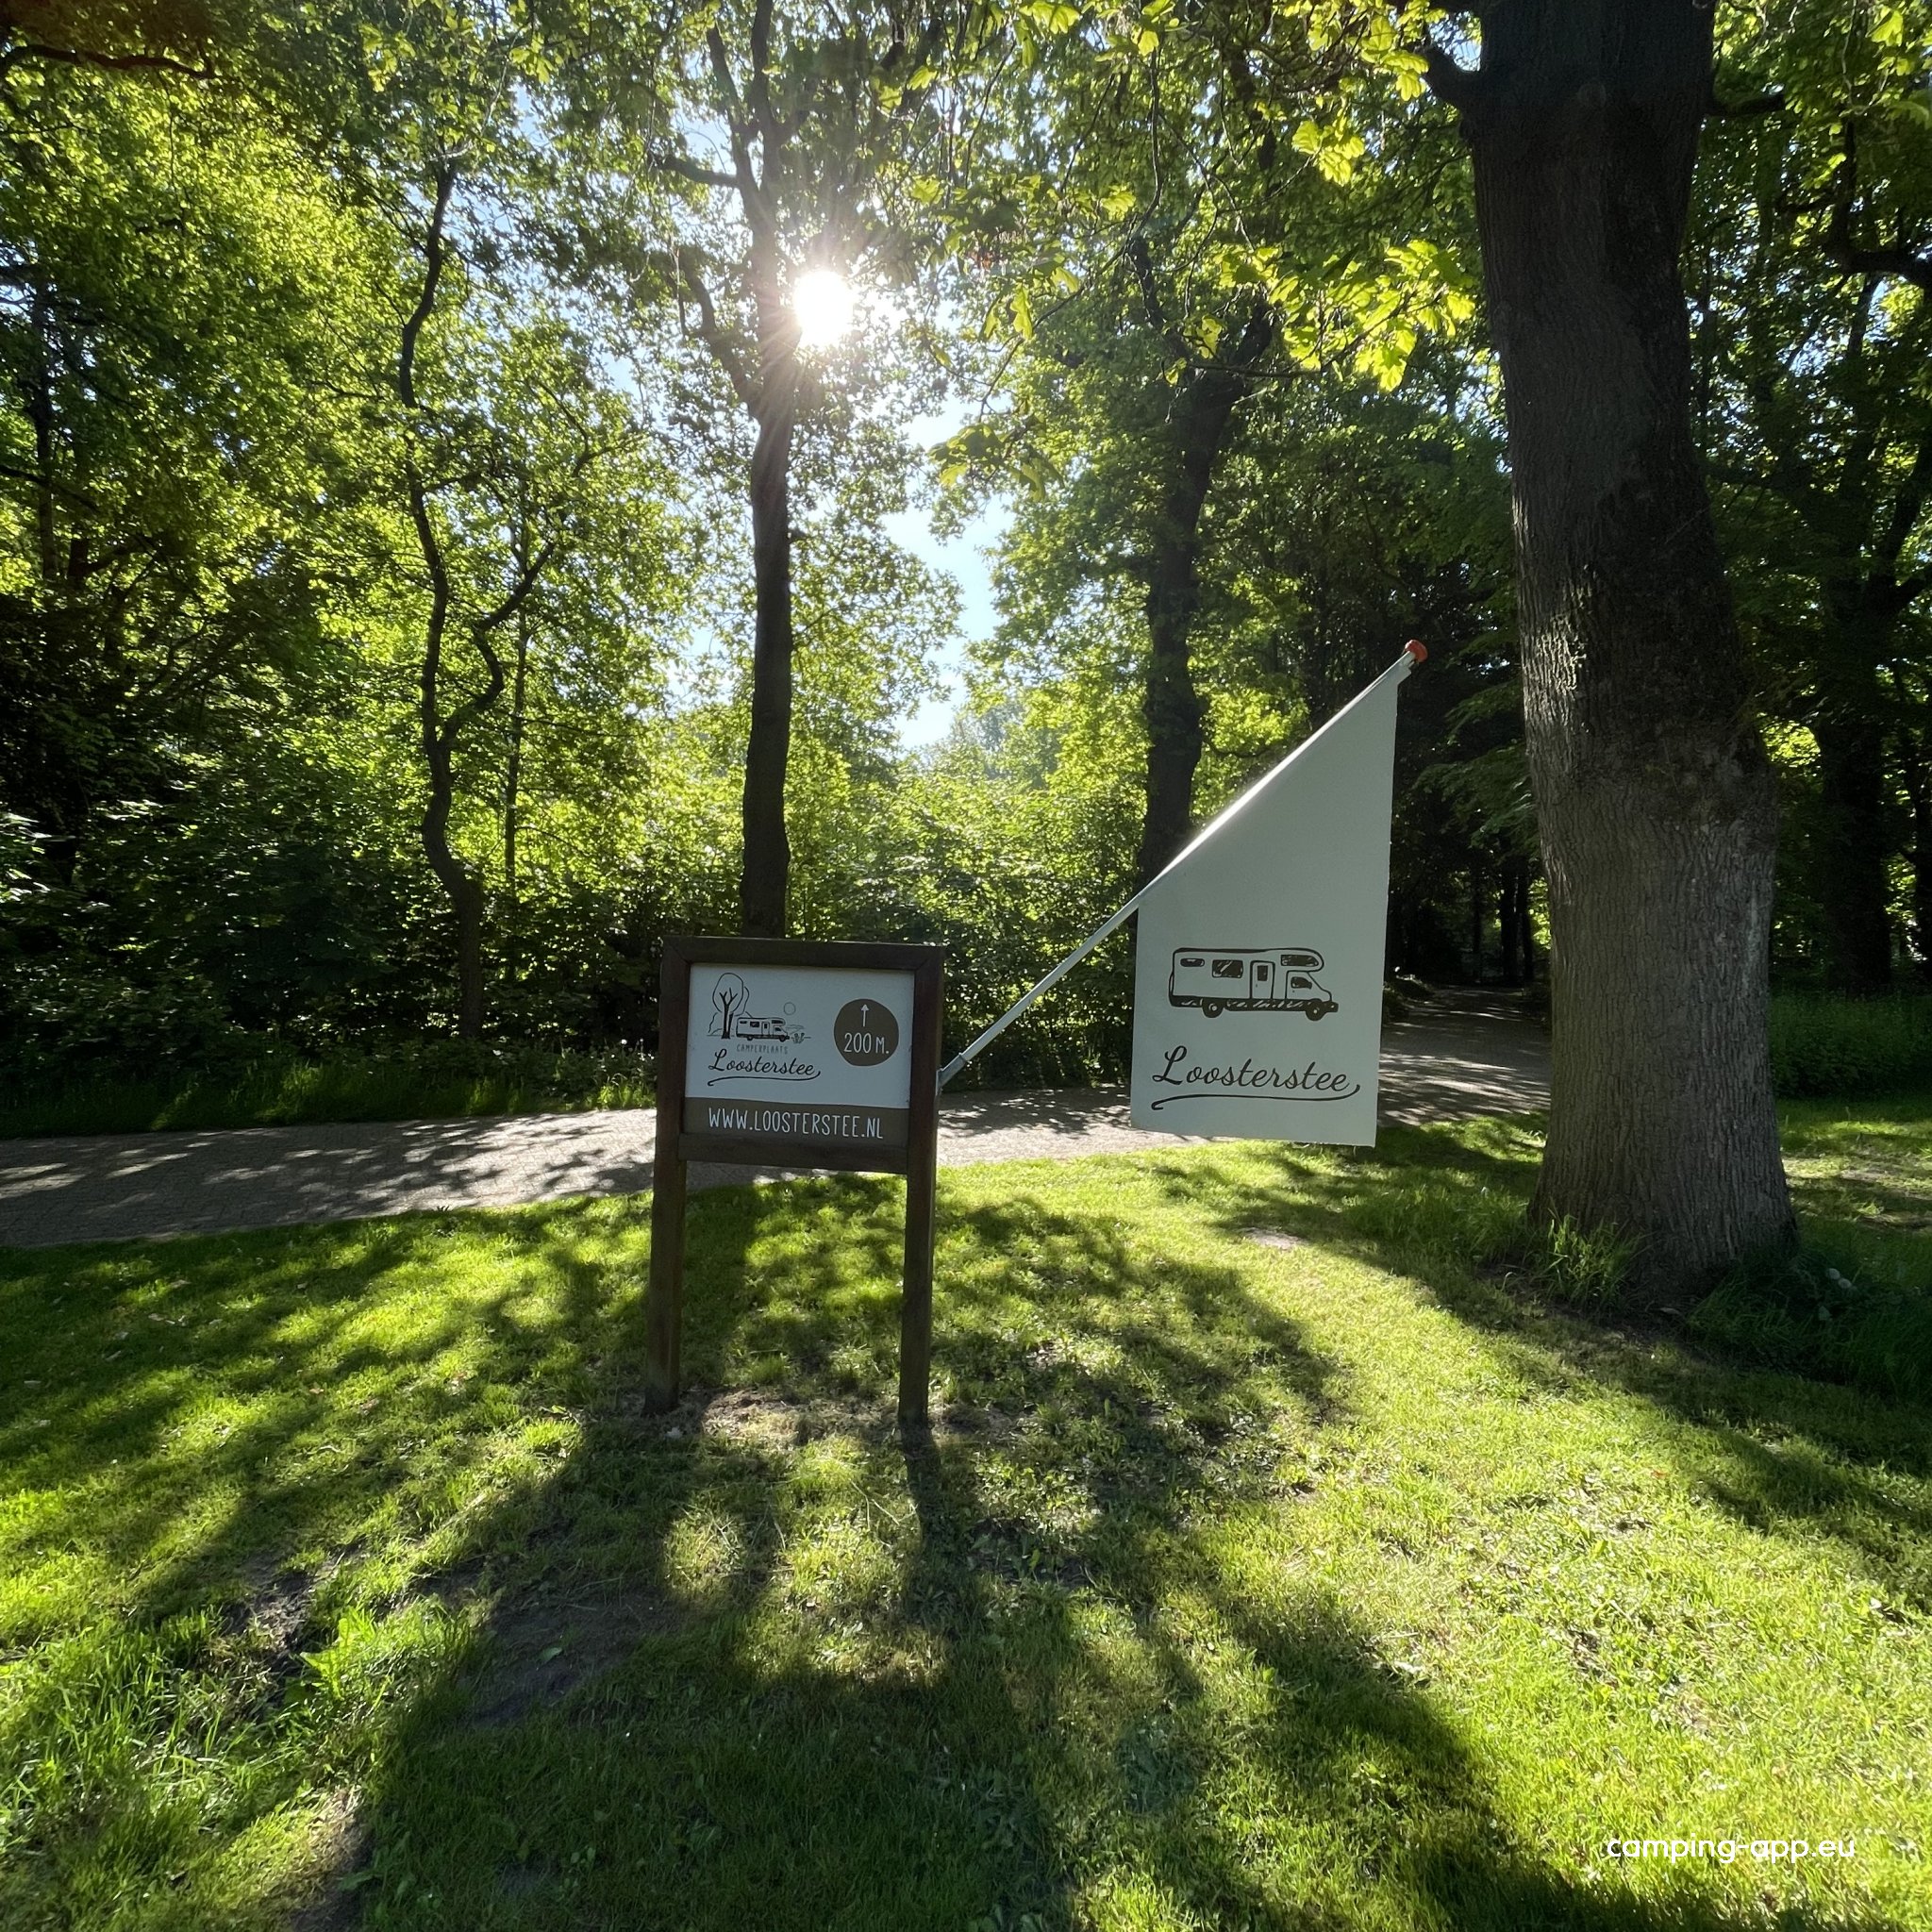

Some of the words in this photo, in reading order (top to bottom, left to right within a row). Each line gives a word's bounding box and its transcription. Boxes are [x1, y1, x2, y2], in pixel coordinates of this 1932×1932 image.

[736, 1043, 789, 1055] CAMPERPLAATS
[843, 1032, 872, 1054] 200
[875, 1036, 890, 1055] M.
[708, 1048, 815, 1075] Loosterstee
[1152, 1045, 1350, 1091] Loosterstee
[708, 1108, 884, 1139] WWW.LOOSTERSTEE.NL
